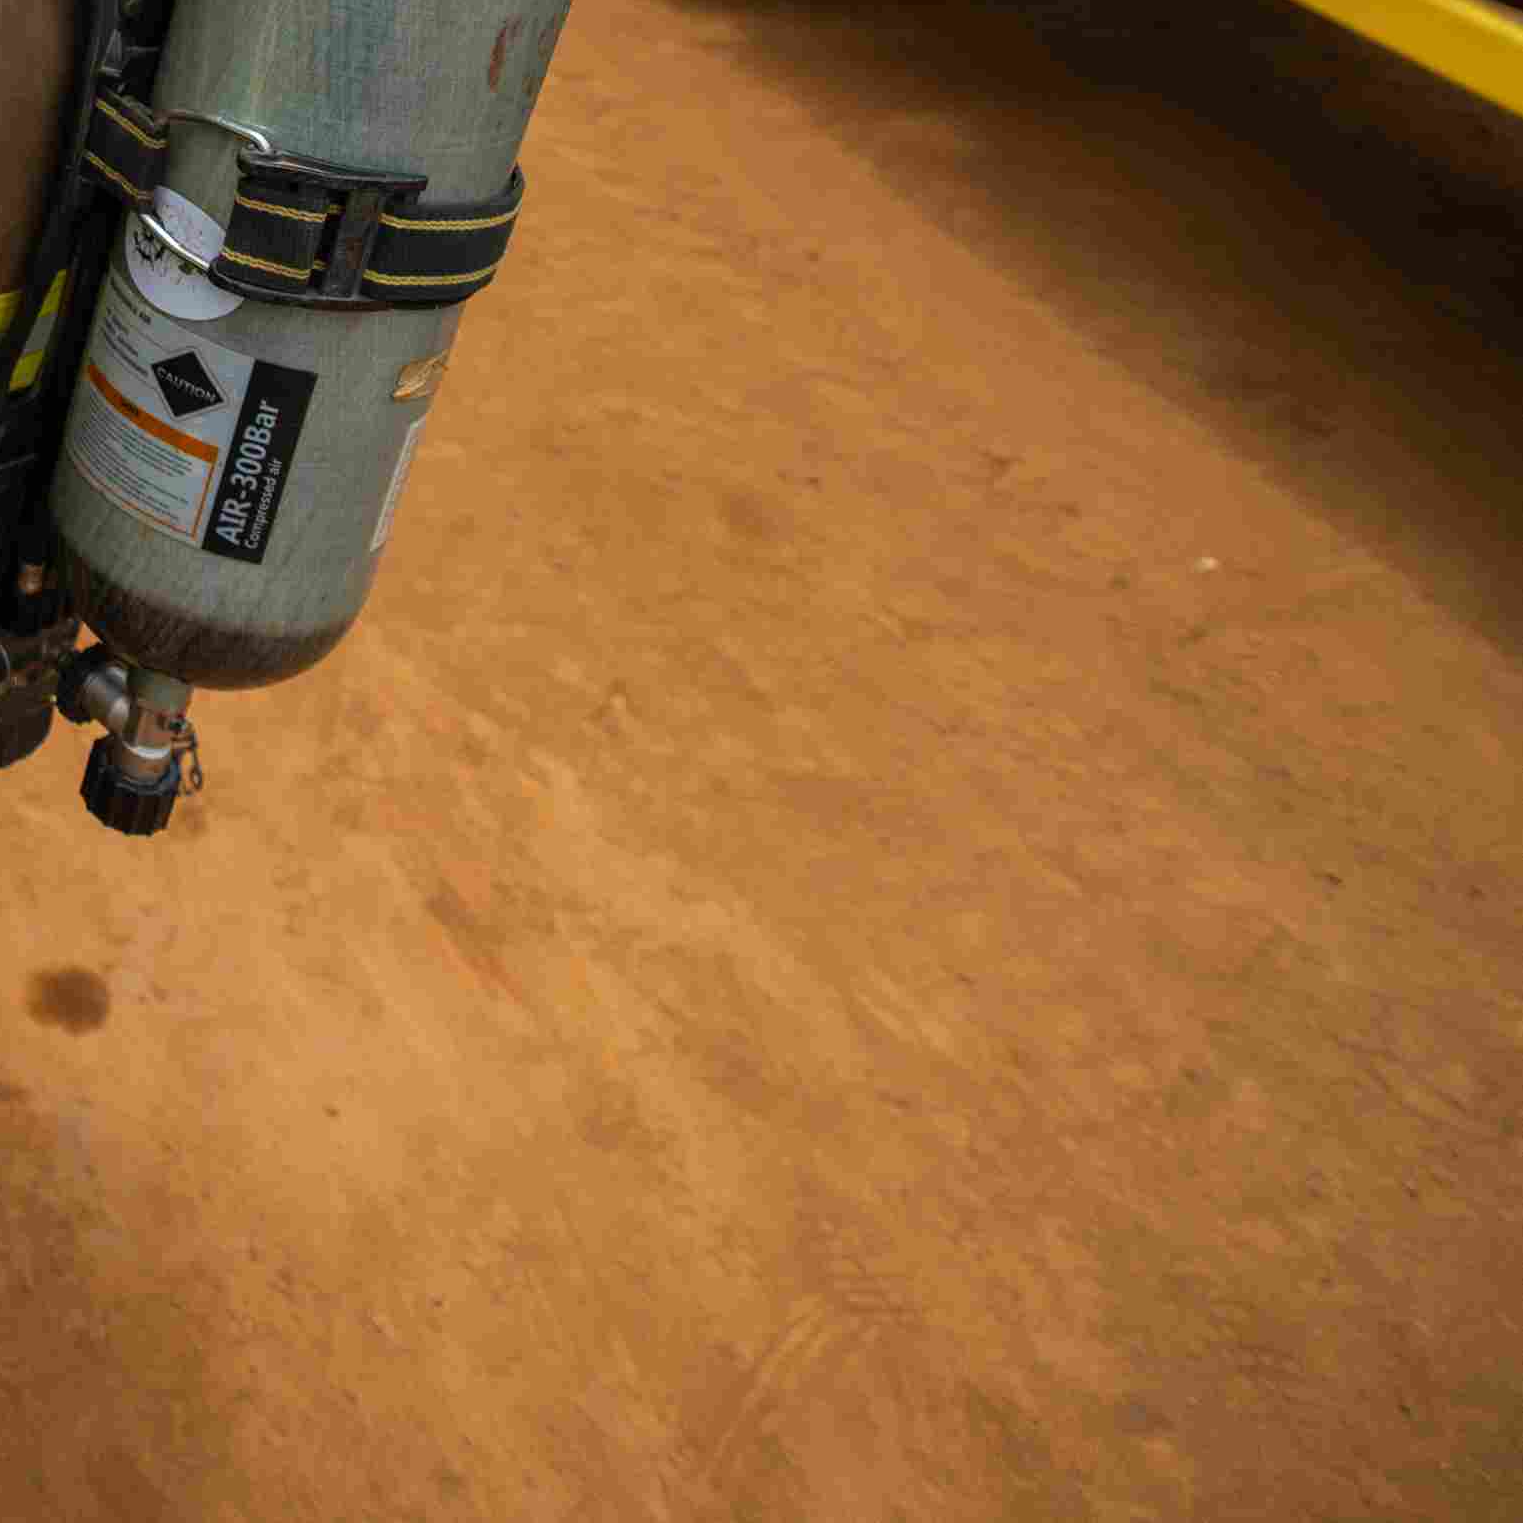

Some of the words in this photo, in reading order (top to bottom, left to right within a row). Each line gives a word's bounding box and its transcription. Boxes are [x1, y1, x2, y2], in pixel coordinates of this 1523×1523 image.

[157, 367, 216, 402] CAUTION
[216, 399, 281, 545] AIR-300Bar
[245, 478, 278, 549] Compressed
[269, 458, 283, 478] air
